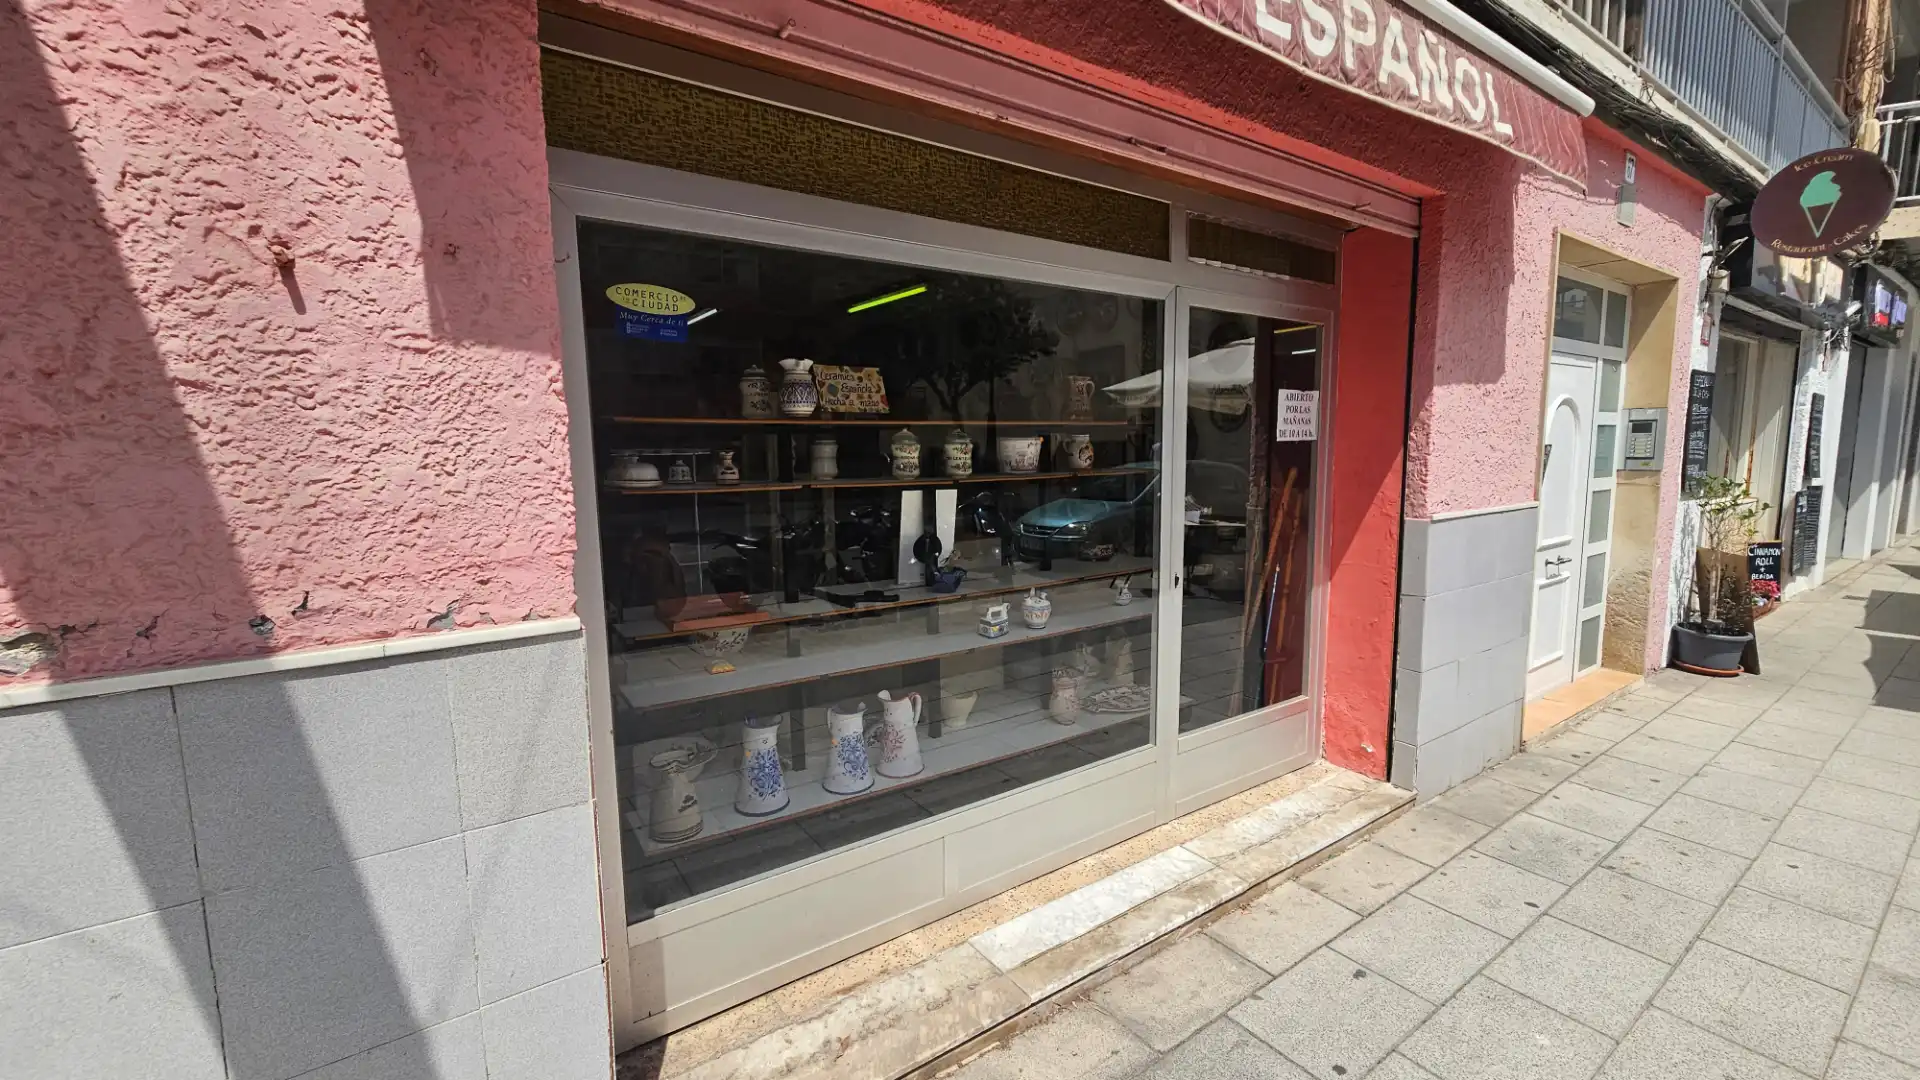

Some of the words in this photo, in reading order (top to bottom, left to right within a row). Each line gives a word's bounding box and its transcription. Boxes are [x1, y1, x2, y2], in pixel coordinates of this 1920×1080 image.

[1814, 154, 1853, 164] Cream
[1770, 238, 1825, 253] Restaurant
[615, 286, 679, 303] COMERCIO
[632, 298, 679, 312] CIUDAD
[619, 311, 638, 321] Muy
[640, 314, 664, 324] Cerca
[666, 317, 676, 325] de
[1284, 392, 1314, 402] ABIERTO
[1285, 405, 1299, 414] POR
[1299, 406, 1311, 414] LAS
[1283, 415, 1311, 425] MAÑANAS
[1279, 429, 1288, 438] DE
[1288, 429, 1296, 438] 10
[1755, 557, 1774, 566] ROLL
